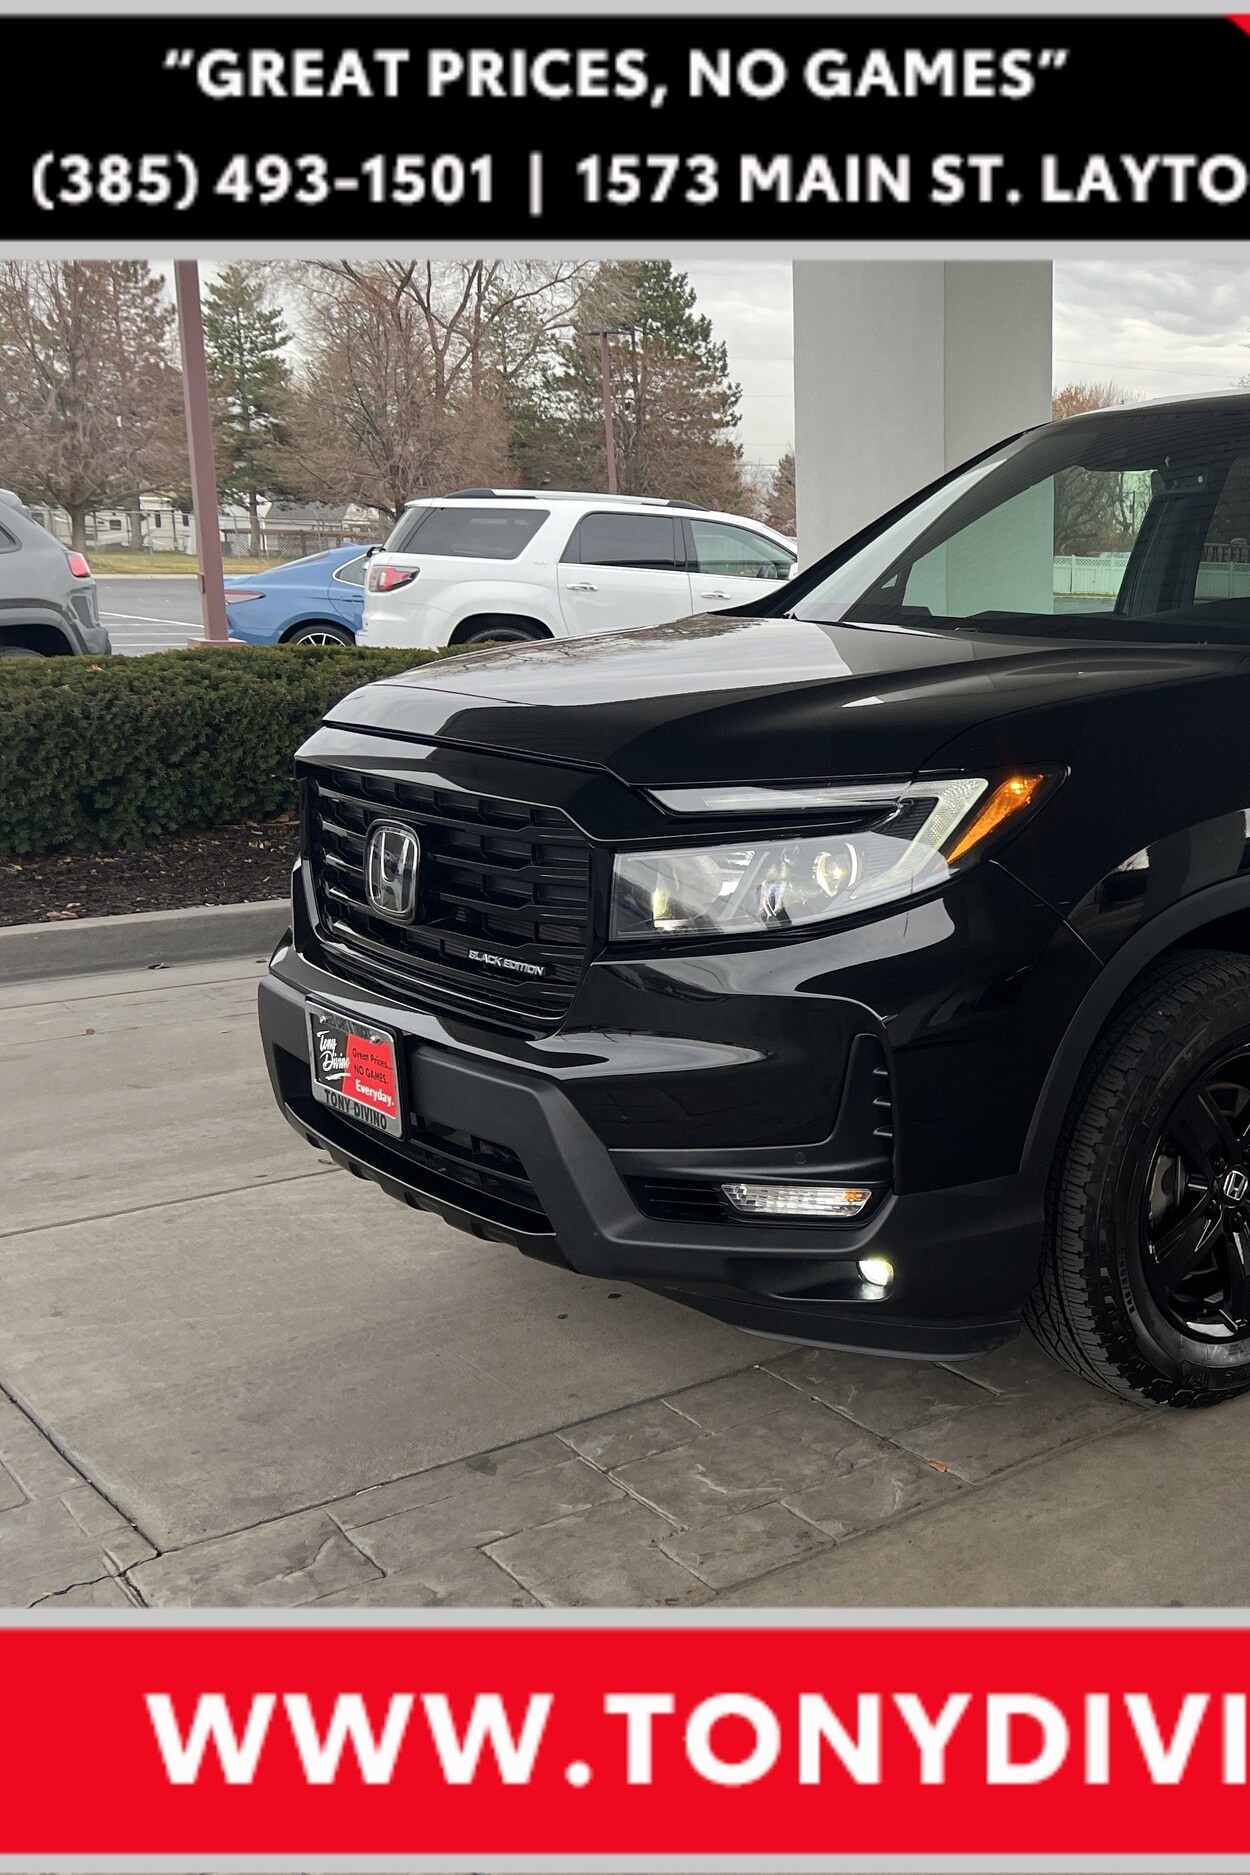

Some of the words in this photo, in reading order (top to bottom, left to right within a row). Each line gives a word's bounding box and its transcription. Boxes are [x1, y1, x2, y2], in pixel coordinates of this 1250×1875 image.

[468, 949, 503, 967] BLACK
[503, 958, 545, 976] EDITION
[317, 1030, 338, 1055] Tony
[352, 1048, 370, 1062] Great
[320, 1051, 351, 1072] Divino
[354, 1064, 364, 1076] NO
[355, 1079, 395, 1107] Everyday.
[324, 1088, 352, 1113] TONY
[353, 1101, 388, 1131] DIVINO
